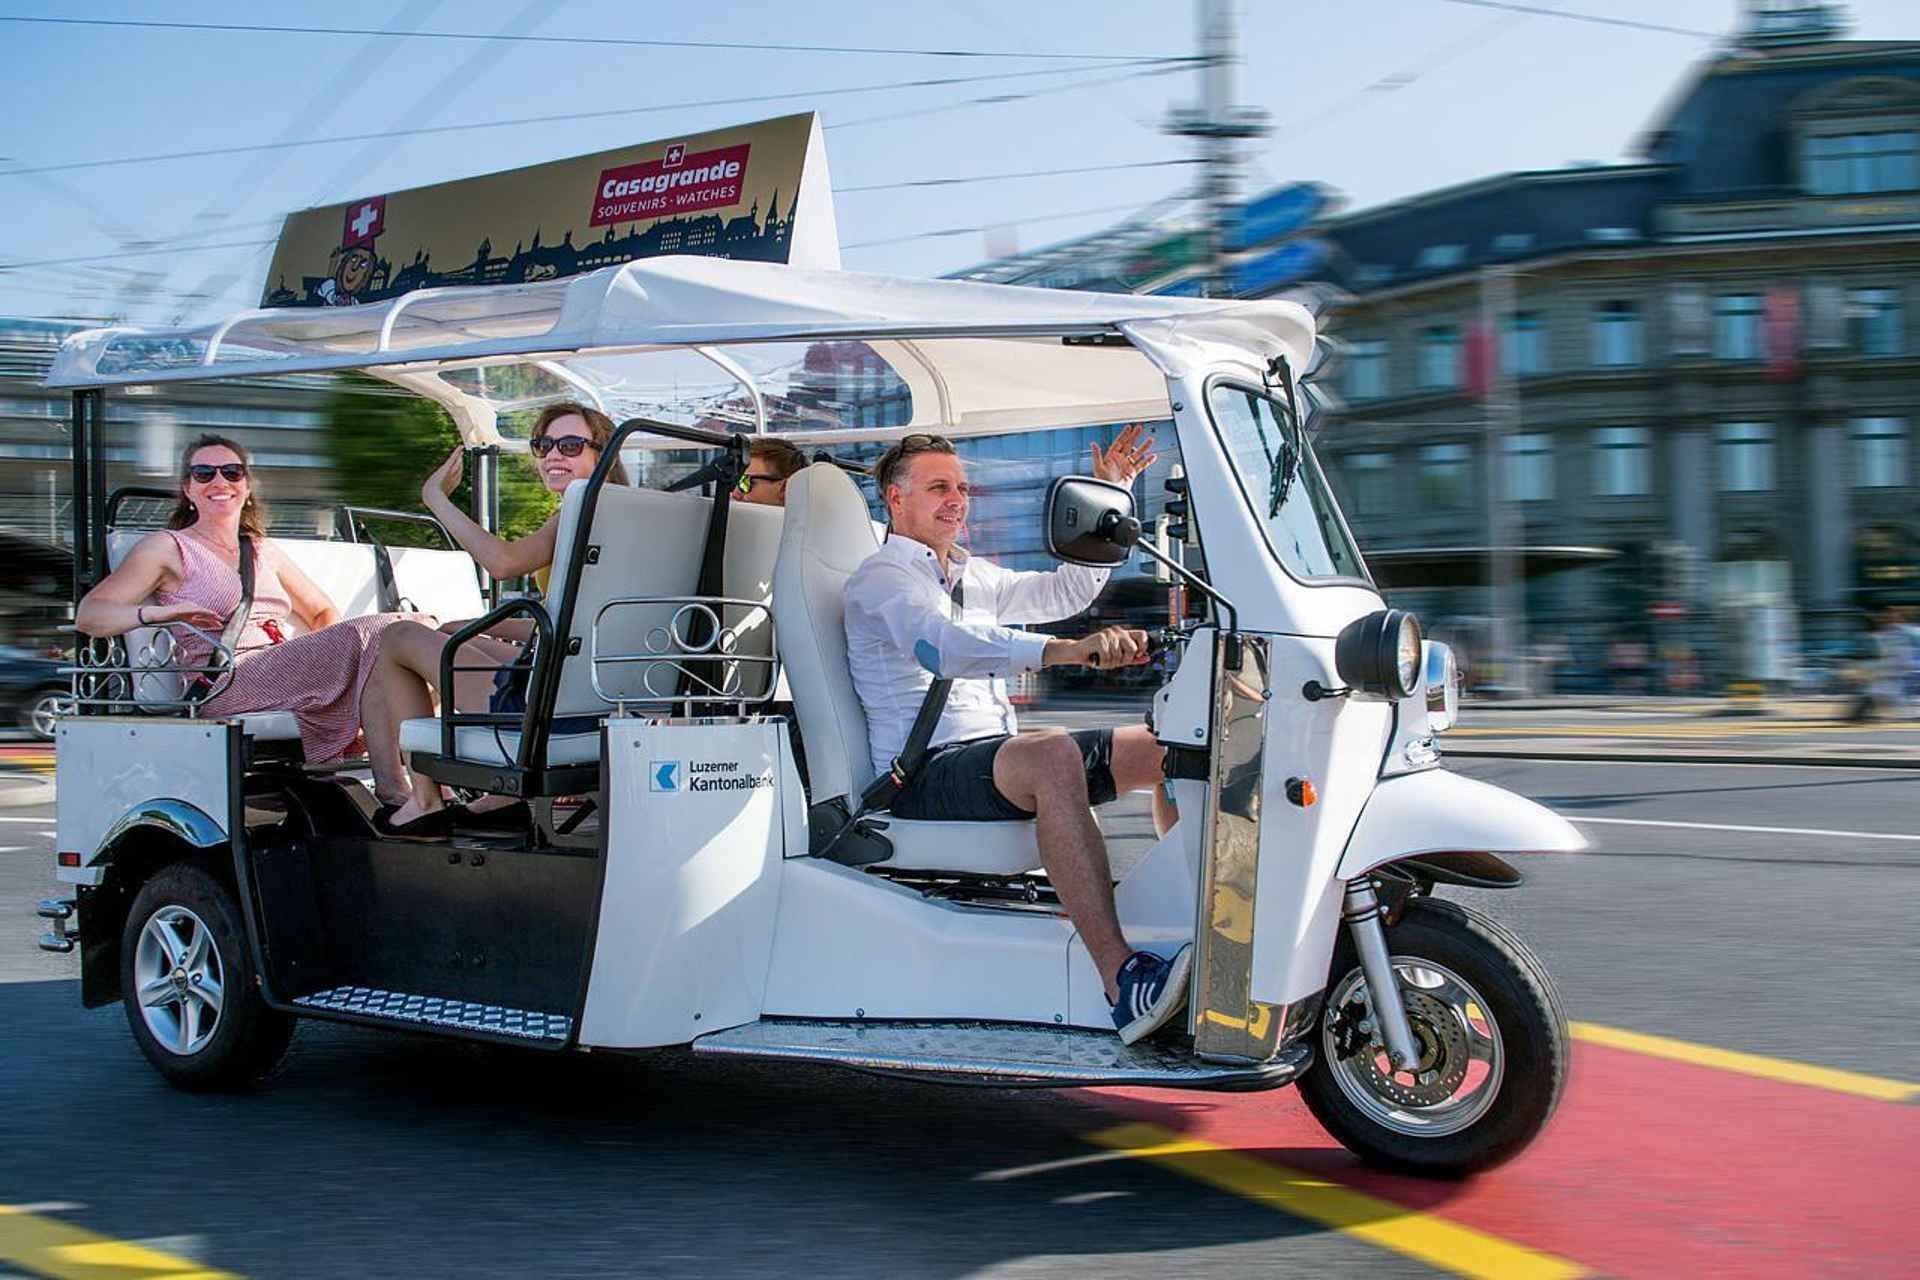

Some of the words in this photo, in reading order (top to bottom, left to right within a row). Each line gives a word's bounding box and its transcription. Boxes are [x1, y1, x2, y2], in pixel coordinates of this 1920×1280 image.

[602, 160, 740, 198] Casagrande
[598, 197, 667, 218] SOUVENIRS
[676, 186, 736, 205] WATCHES
[689, 760, 738, 773] Luzerner
[689, 774, 775, 791] Kantonalbank
